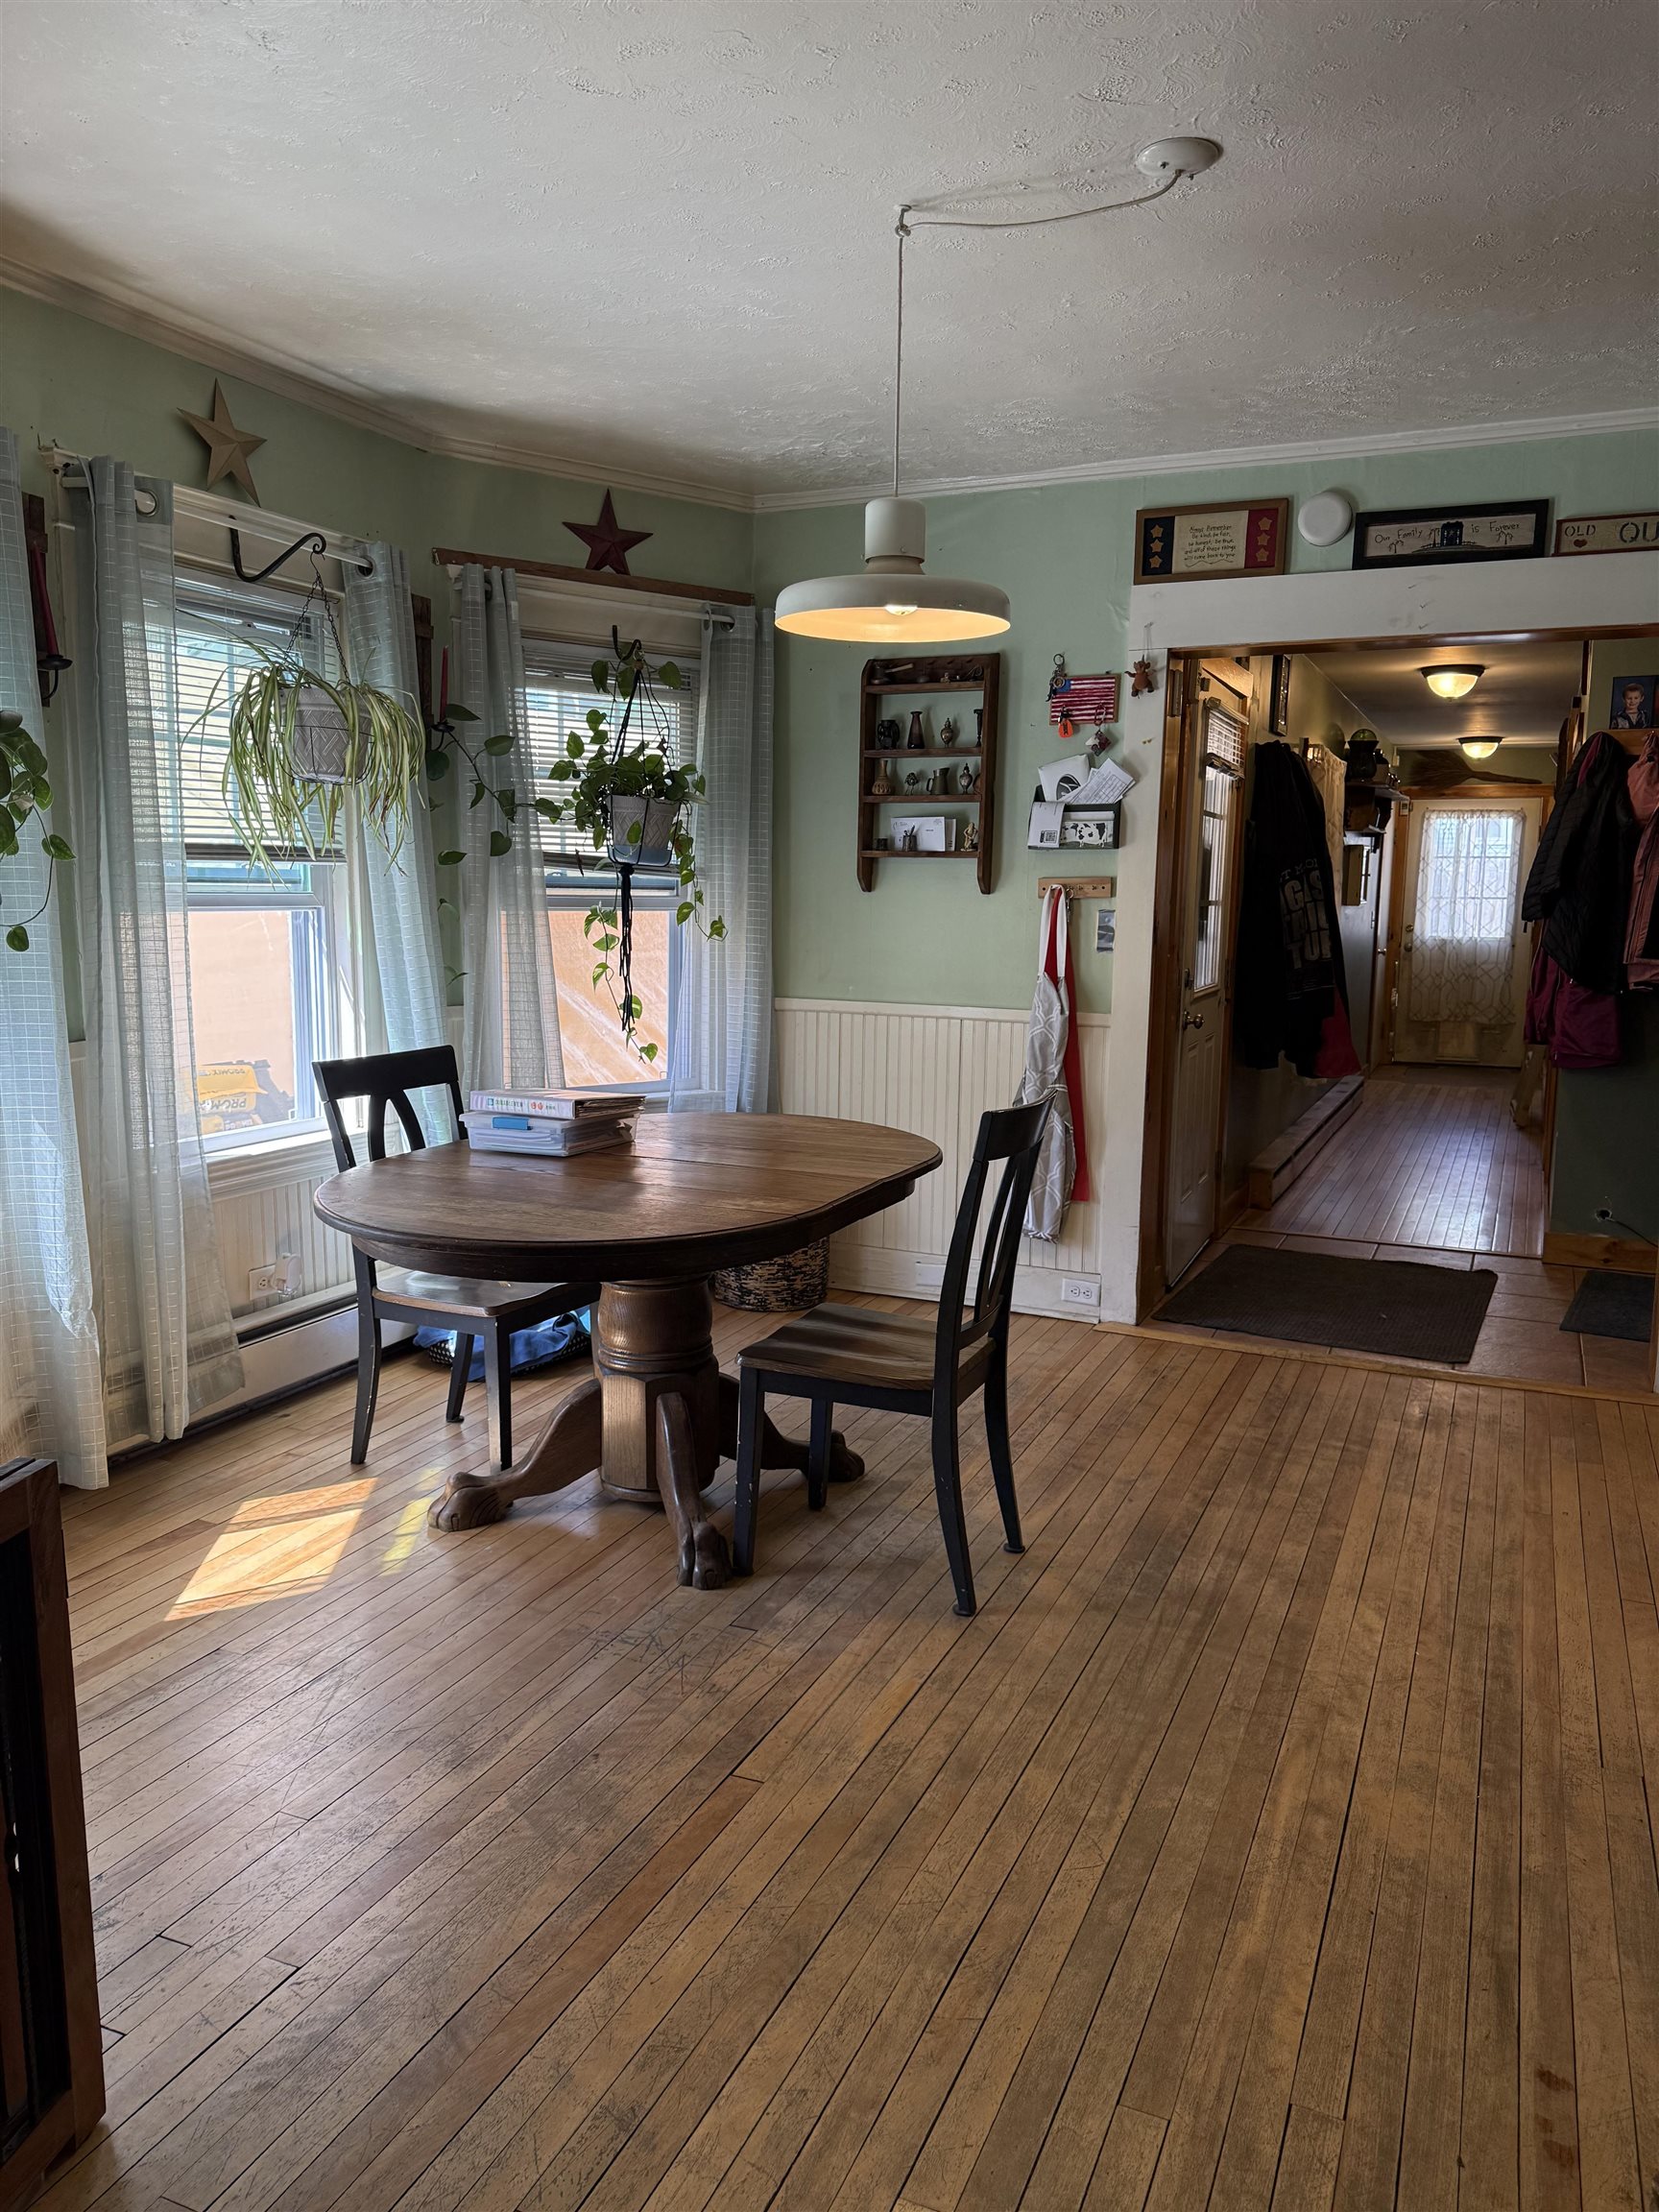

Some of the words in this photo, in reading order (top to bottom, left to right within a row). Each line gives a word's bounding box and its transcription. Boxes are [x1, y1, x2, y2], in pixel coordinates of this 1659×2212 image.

[1375, 534, 1390, 543] Our
[1397, 527, 1423, 539] Family
[1471, 524, 1479, 533] is
[1489, 520, 1520, 532] Forever
[1565, 524, 1596, 537] OLD
